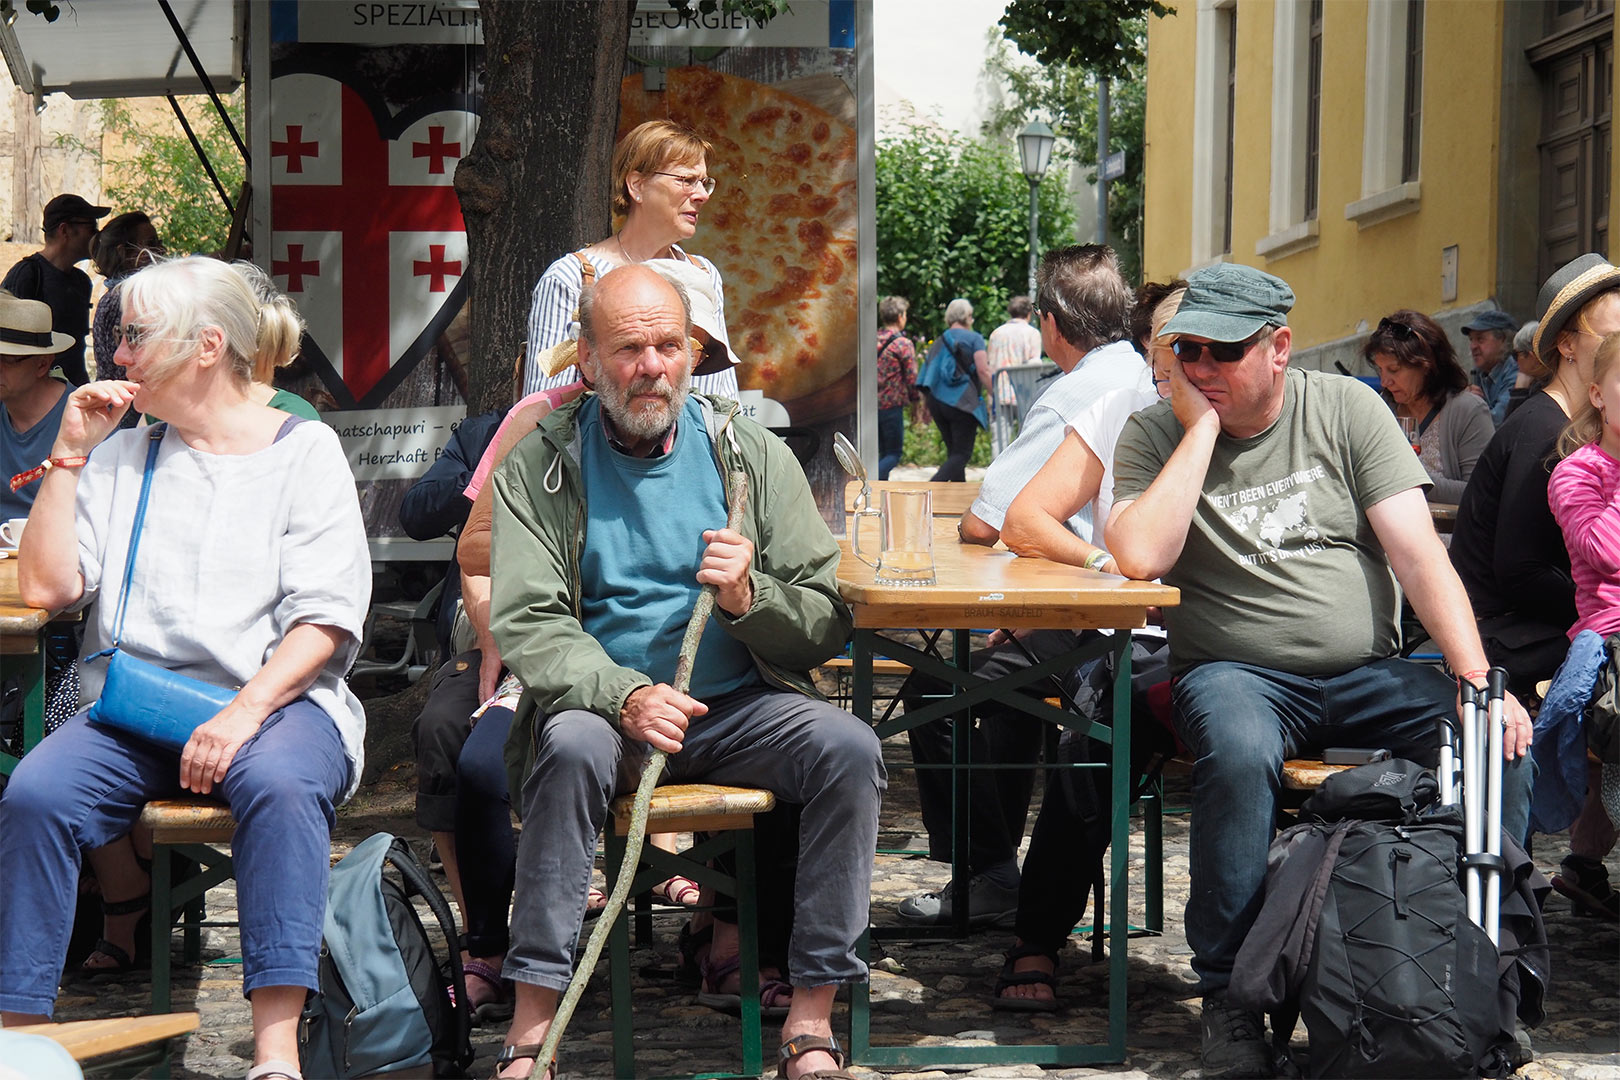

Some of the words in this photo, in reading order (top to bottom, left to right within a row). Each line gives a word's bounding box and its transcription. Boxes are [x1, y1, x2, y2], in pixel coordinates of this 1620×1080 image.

[332, 419, 426, 440] hatschapuri
[358, 447, 428, 466] Herzhaft
[1239, 485, 1266, 504] BEEN
[1265, 465, 1325, 497] EVERYWHERE
[1238, 553, 1257, 566] BUT
[999, 607, 1043, 618] SAALFELD
